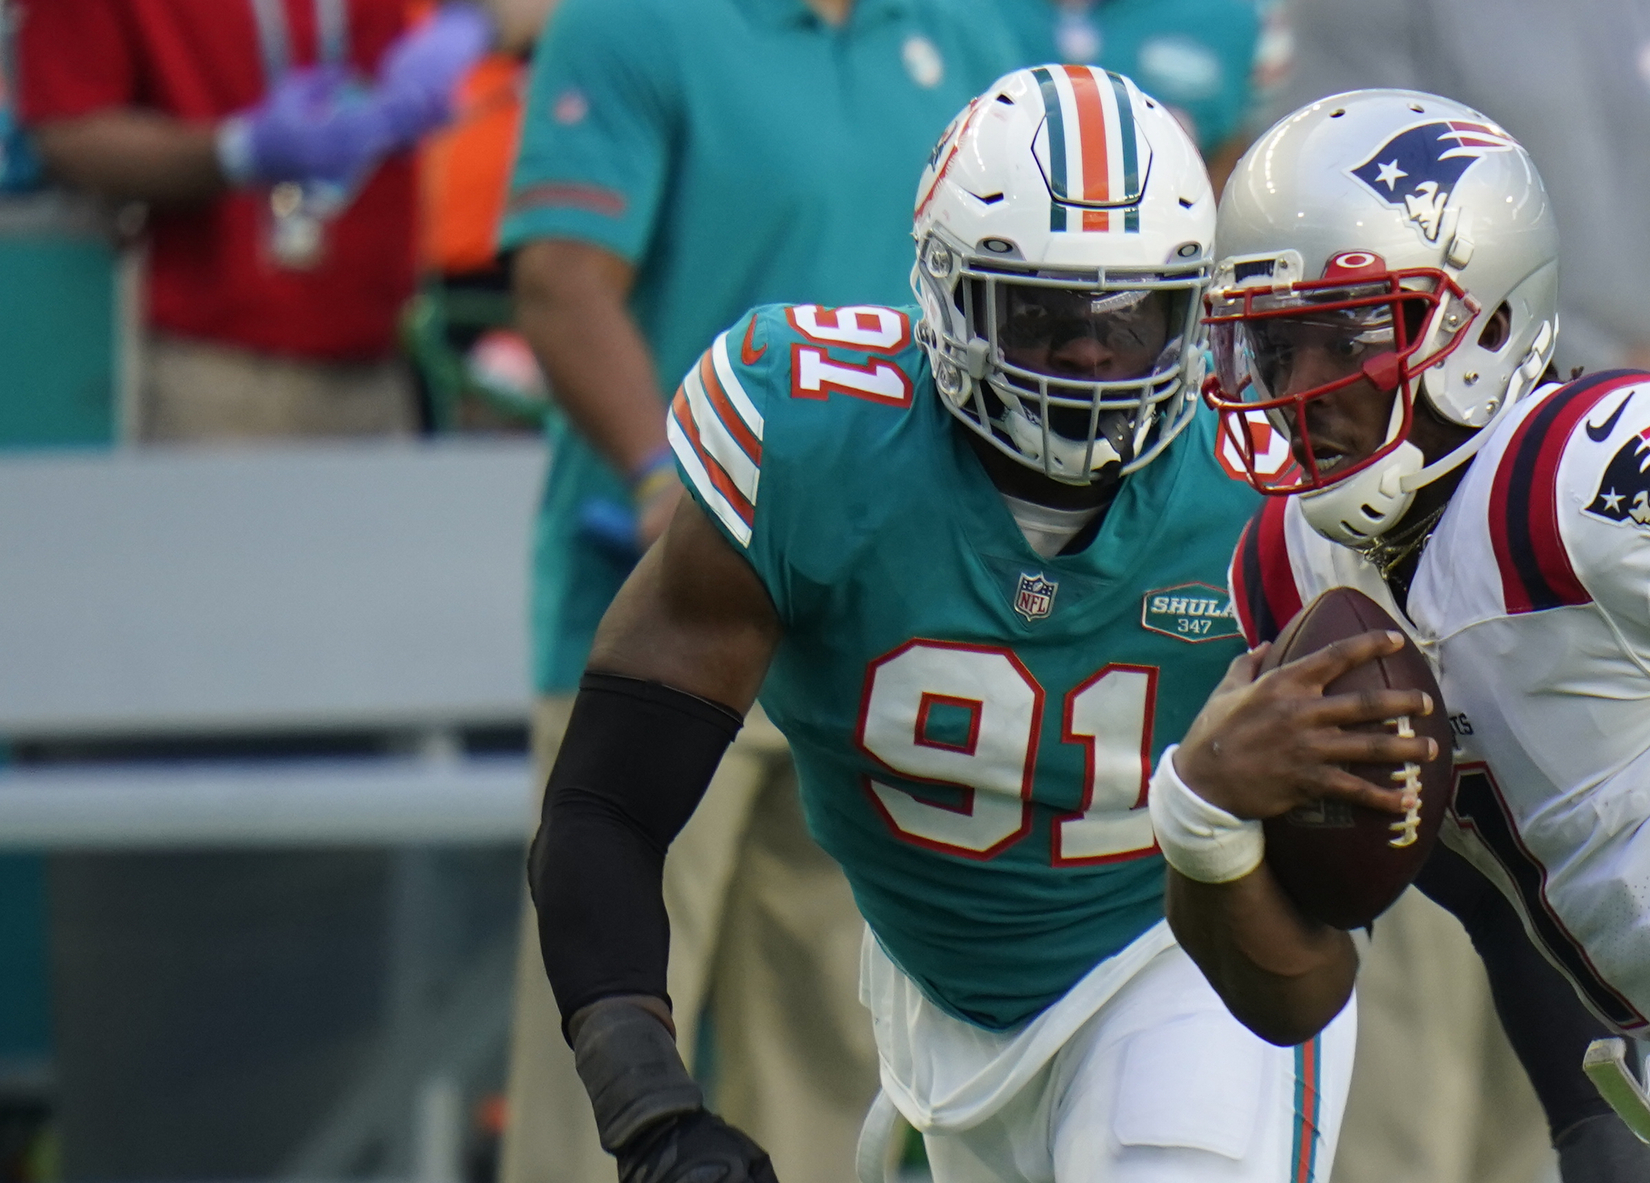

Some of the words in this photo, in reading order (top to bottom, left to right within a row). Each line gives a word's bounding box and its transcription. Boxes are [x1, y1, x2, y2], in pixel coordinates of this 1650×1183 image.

[784, 304, 913, 409] 91
[1018, 592, 1046, 615] NFL
[1177, 618, 1212, 634] 347
[855, 637, 1164, 869] 91
